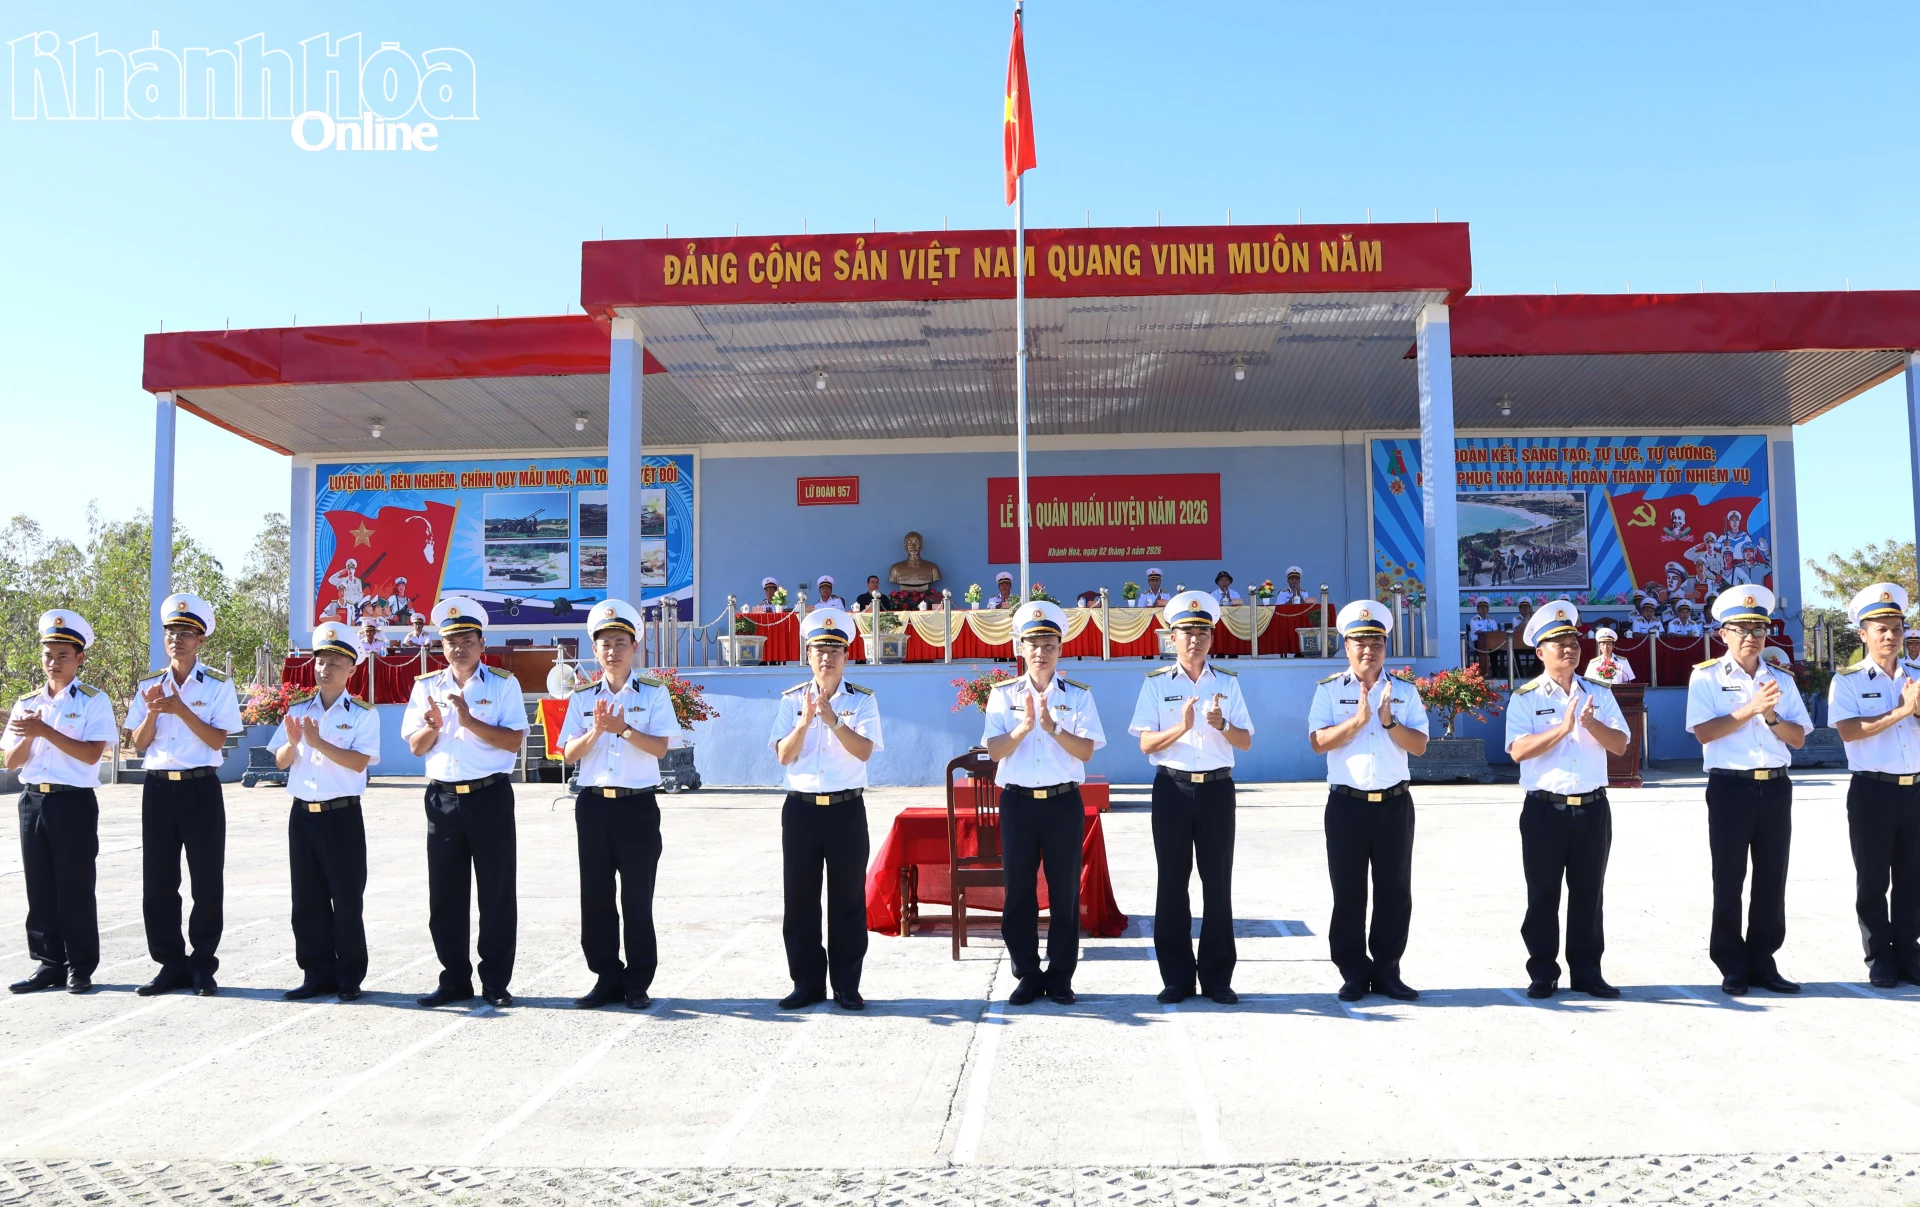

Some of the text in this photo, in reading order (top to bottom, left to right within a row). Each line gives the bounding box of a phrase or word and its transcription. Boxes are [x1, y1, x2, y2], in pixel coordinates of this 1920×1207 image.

[663, 243, 738, 286] ĐẢNG
[748, 242, 821, 289] CỘNG
[833, 238, 888, 281] SẢN
[900, 240, 960, 286] VIỆT
[1048, 243, 1141, 283] QUANG
[1151, 243, 1215, 276] VINH
[1228, 233, 1310, 274] MUÔN
[1320, 234, 1383, 273] NĂM
[1491, 444, 1518, 464] KẾT,
[1521, 445, 1558, 463] SÁNG
[1561, 447, 1591, 465] TẠO;
[1594, 445, 1612, 465] TỰ
[1614, 445, 1643, 465] LỰC,
[1646, 445, 1665, 464] TỰ
[1667, 443, 1716, 463] CƯỜNG;
[328, 472, 362, 494] LUYỆN
[363, 470, 388, 491] GIỎI,
[390, 471, 412, 490] RÈN
[414, 470, 459, 491] NGHIÊM,
[460, 469, 494, 489] CHÍNH
[495, 468, 516, 488] QUY
[518, 465, 545, 487] MẪU
[545, 467, 574, 490] MỰC,
[576, 468, 593, 485] AN
[658, 461, 678, 483] ĐỐI
[1456, 465, 1750, 490] PHỤC KHÓ KHĂN; HOÀN THÀNH TỐT NHIỆM VỤ
[815, 483, 836, 498] ĐOÀN
[837, 485, 851, 498] 957
[1000, 494, 1014, 528] LỄ
[1036, 497, 1069, 530] QUÂN
[1071, 492, 1105, 527] HUẤN
[1107, 495, 1145, 532] LUYỆN
[1148, 495, 1176, 525] NĂM
[1179, 499, 1208, 525] 2026
[1047, 547, 1067, 557] Khánh
[1083, 546, 1098, 557] ngày
[1099, 546, 1108, 556] 02
[1108, 546, 1125, 557] tháng
[1126, 546, 1131, 556] 3
[1131, 546, 1145, 555] năm
[1146, 546, 1162, 555] 2026
